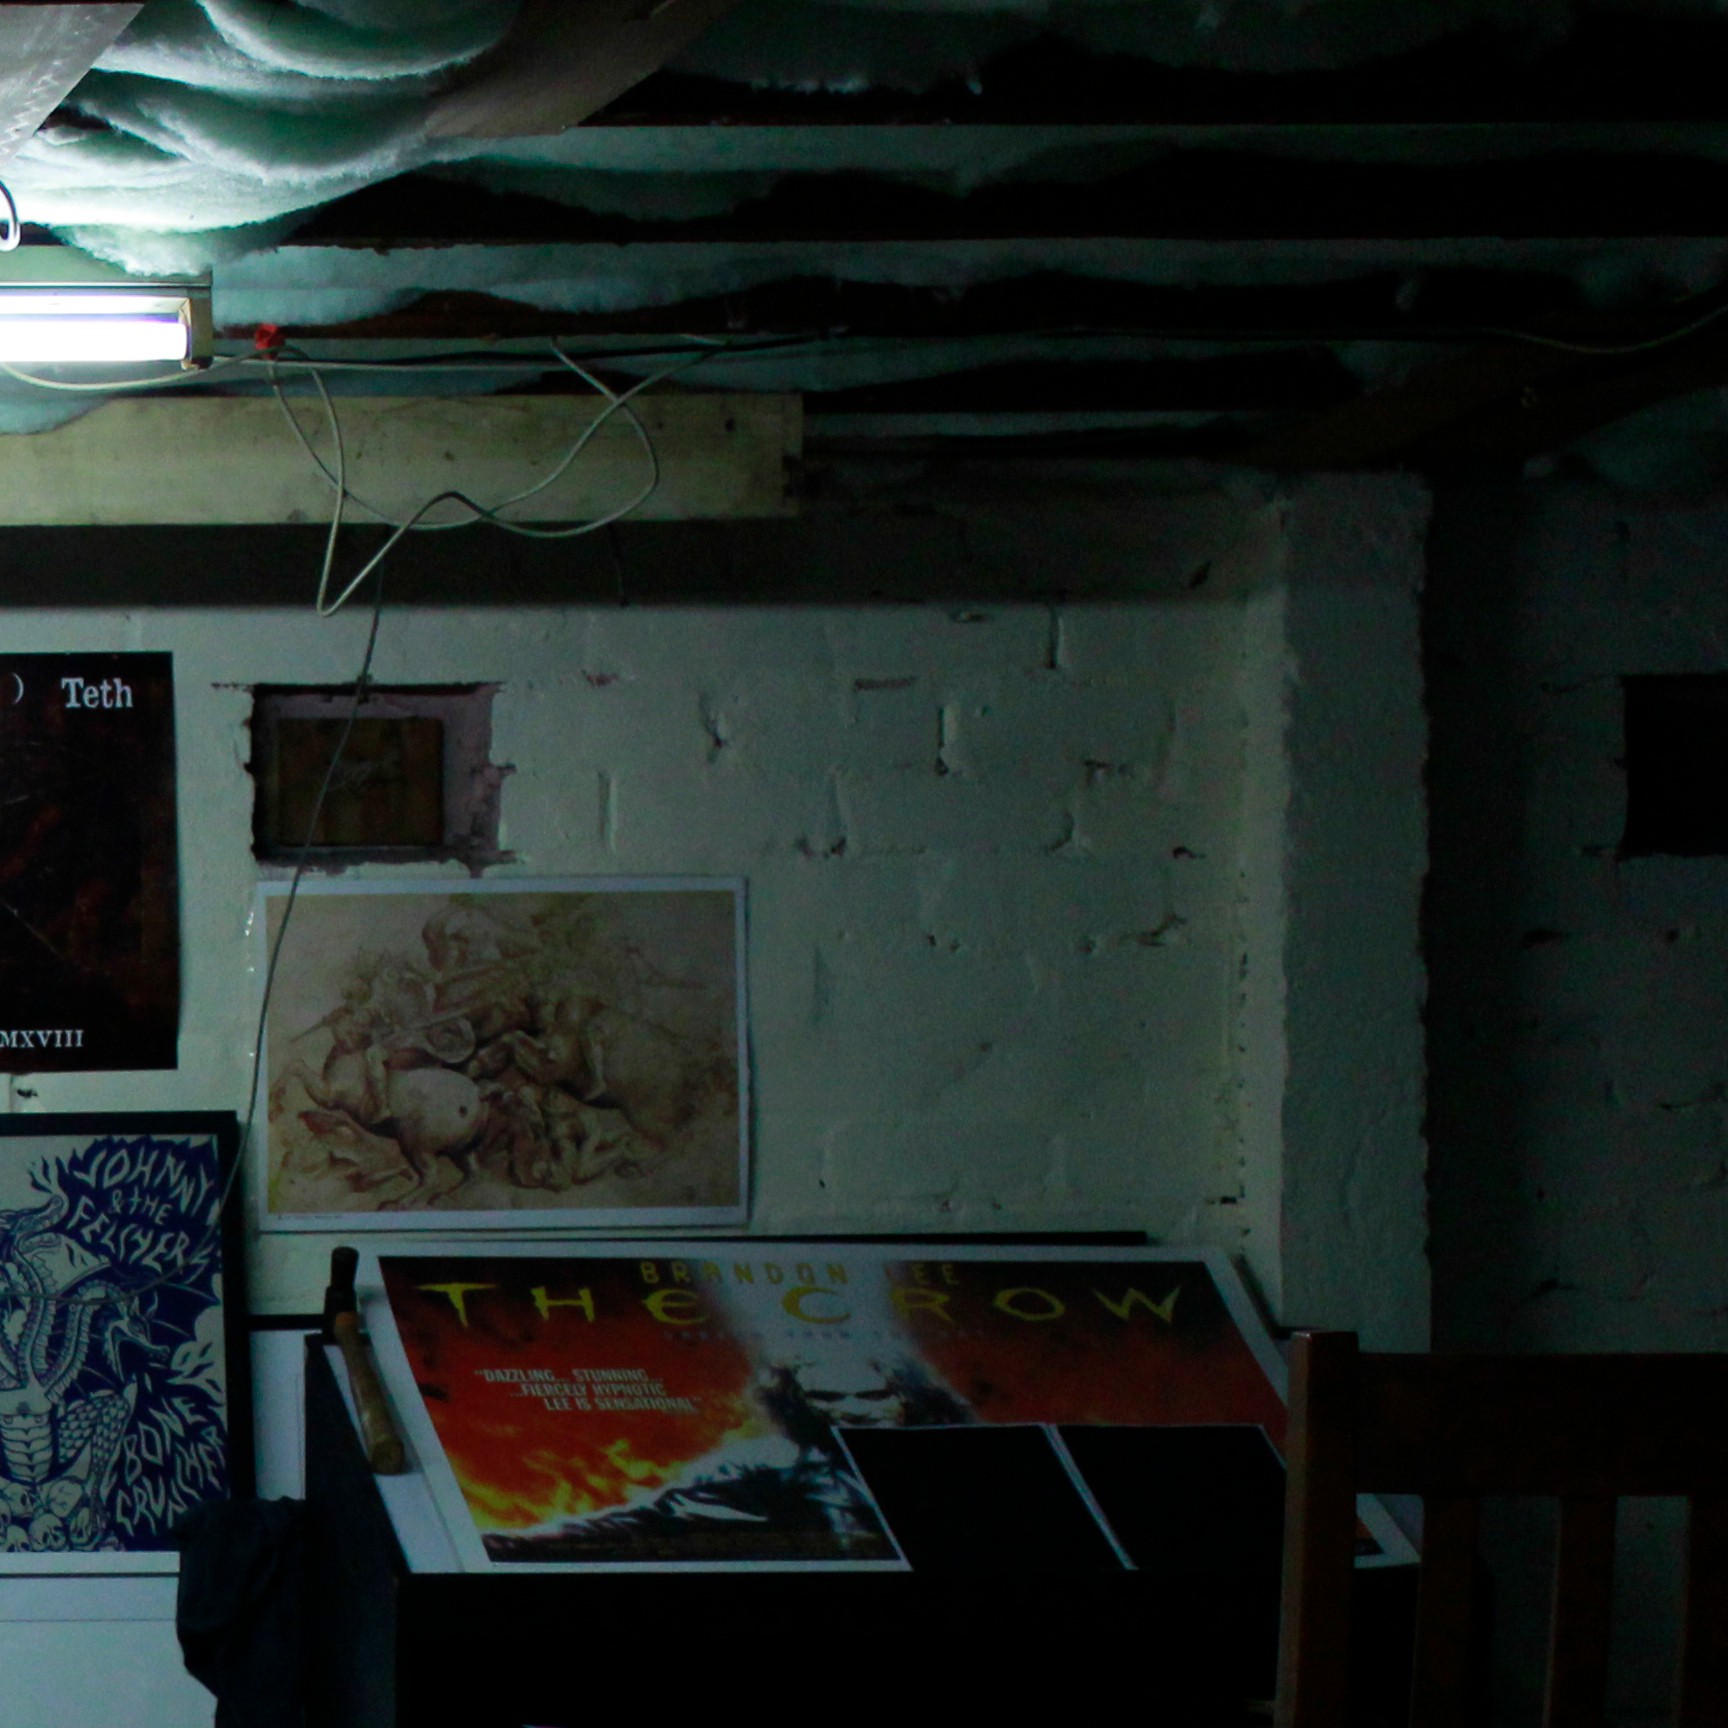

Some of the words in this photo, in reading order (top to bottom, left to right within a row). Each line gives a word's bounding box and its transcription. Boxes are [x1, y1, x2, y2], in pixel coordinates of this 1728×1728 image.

[61, 677, 133, 708] Teth
[77, 1147, 213, 1216] JOHNNY
[640, 1261, 850, 1286] BRANDON
[884, 1263, 960, 1285] LEE
[415, 1281, 711, 1328] THE
[781, 1283, 1182, 1326] CROW
[544, 1397, 572, 1411] LEE
[591, 1383, 665, 1398] HYPNOTIC
[122, 1396, 210, 1488] BONE
